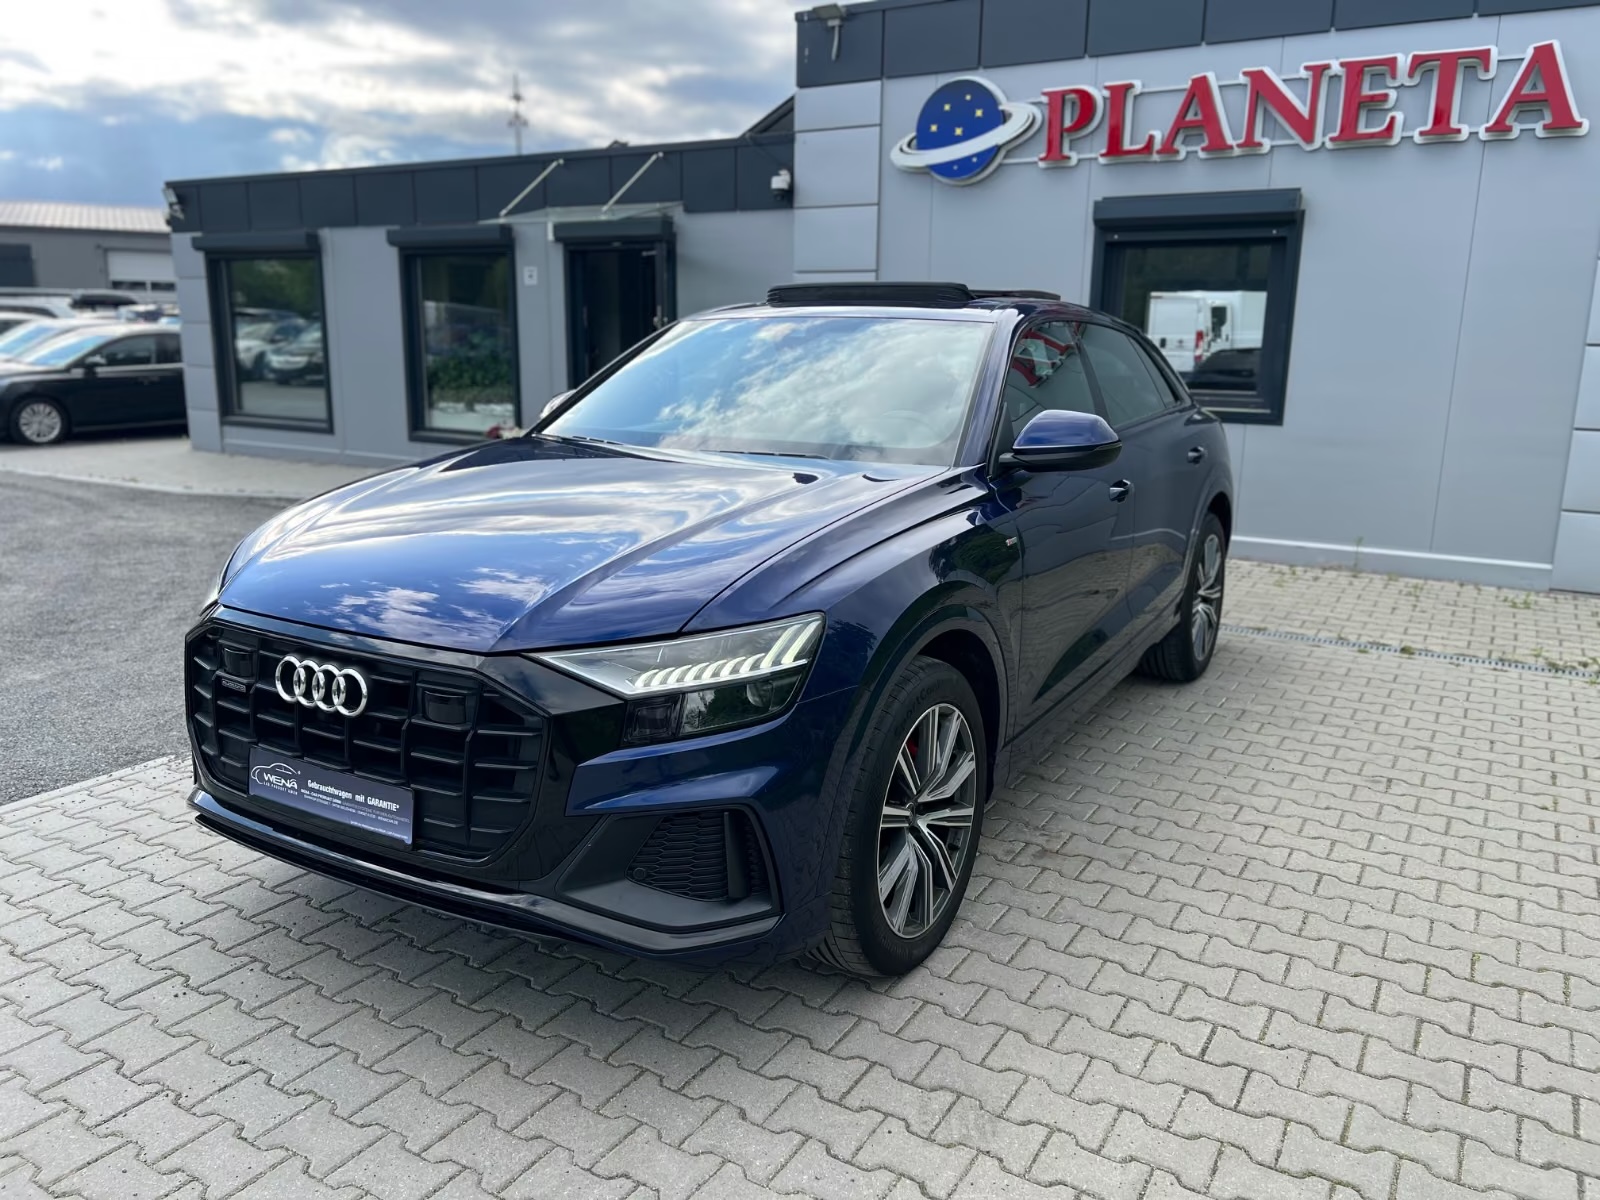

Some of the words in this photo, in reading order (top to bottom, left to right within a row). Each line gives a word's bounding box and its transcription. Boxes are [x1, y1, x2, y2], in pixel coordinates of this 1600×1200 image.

[1038, 40, 1589, 167] PLANETA
[307, 779, 353, 799] Gebrauchtwagen
[354, 793, 365, 803] mit
